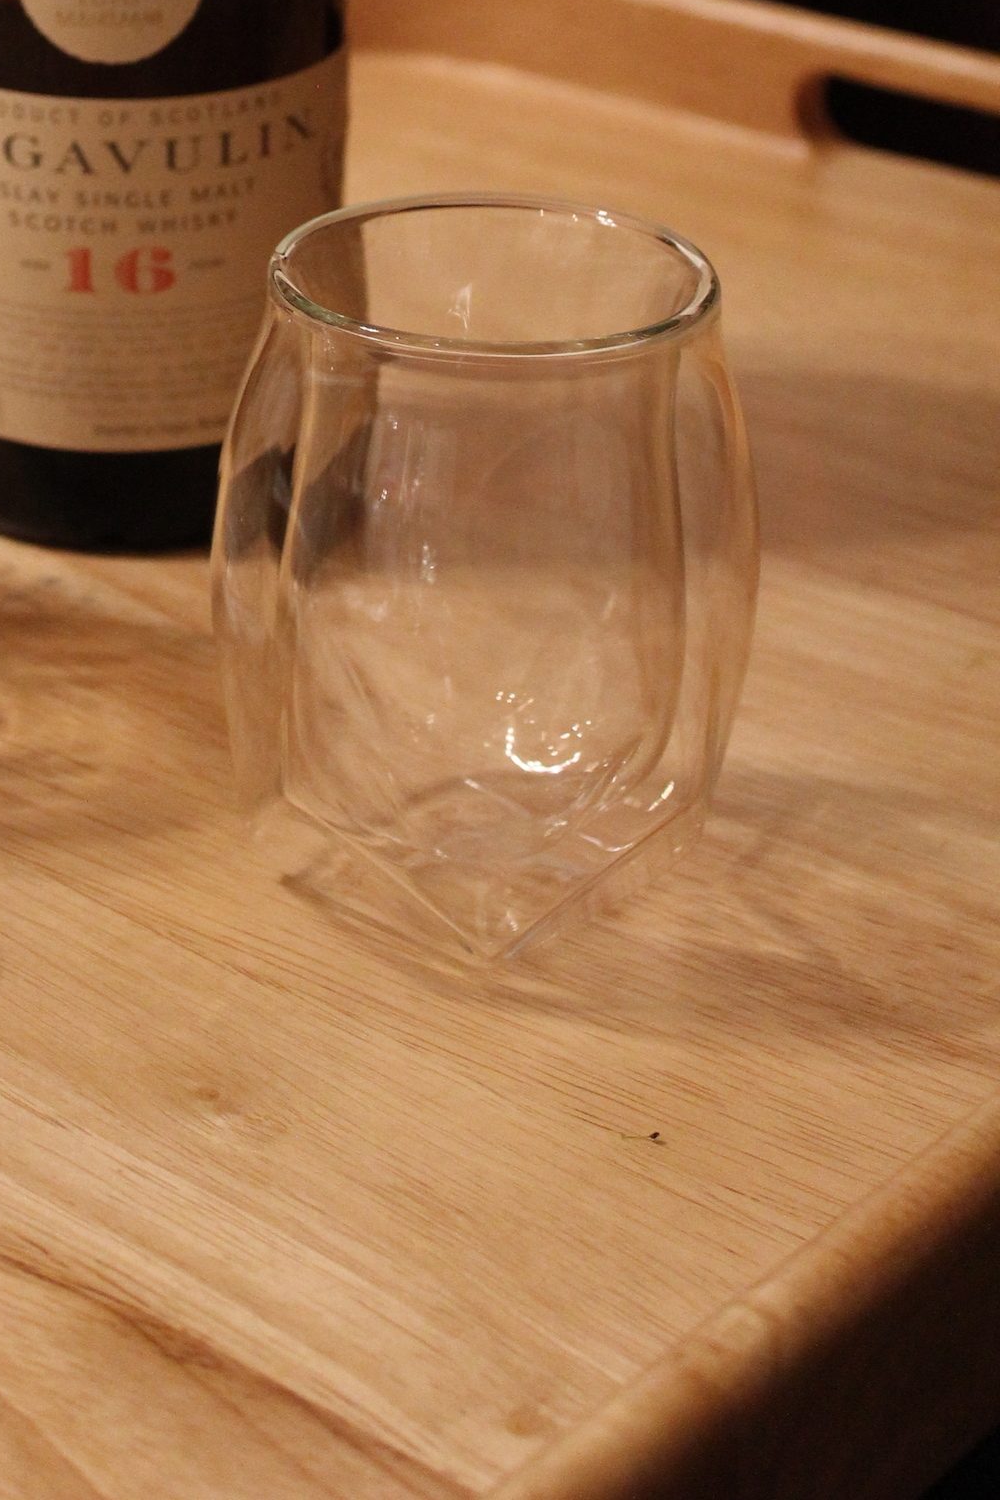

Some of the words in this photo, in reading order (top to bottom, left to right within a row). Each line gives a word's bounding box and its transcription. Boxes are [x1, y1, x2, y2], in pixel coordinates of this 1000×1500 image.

[98, 108, 130, 127] OF
[150, 90, 281, 127] SCOTLAND
[76, 188, 170, 209] SINGLE
[190, 176, 255, 202] MALT
[8, 209, 118, 236] SCOTCH
[135, 207, 237, 234] WHISKY
[66, 247, 176, 295] 16
